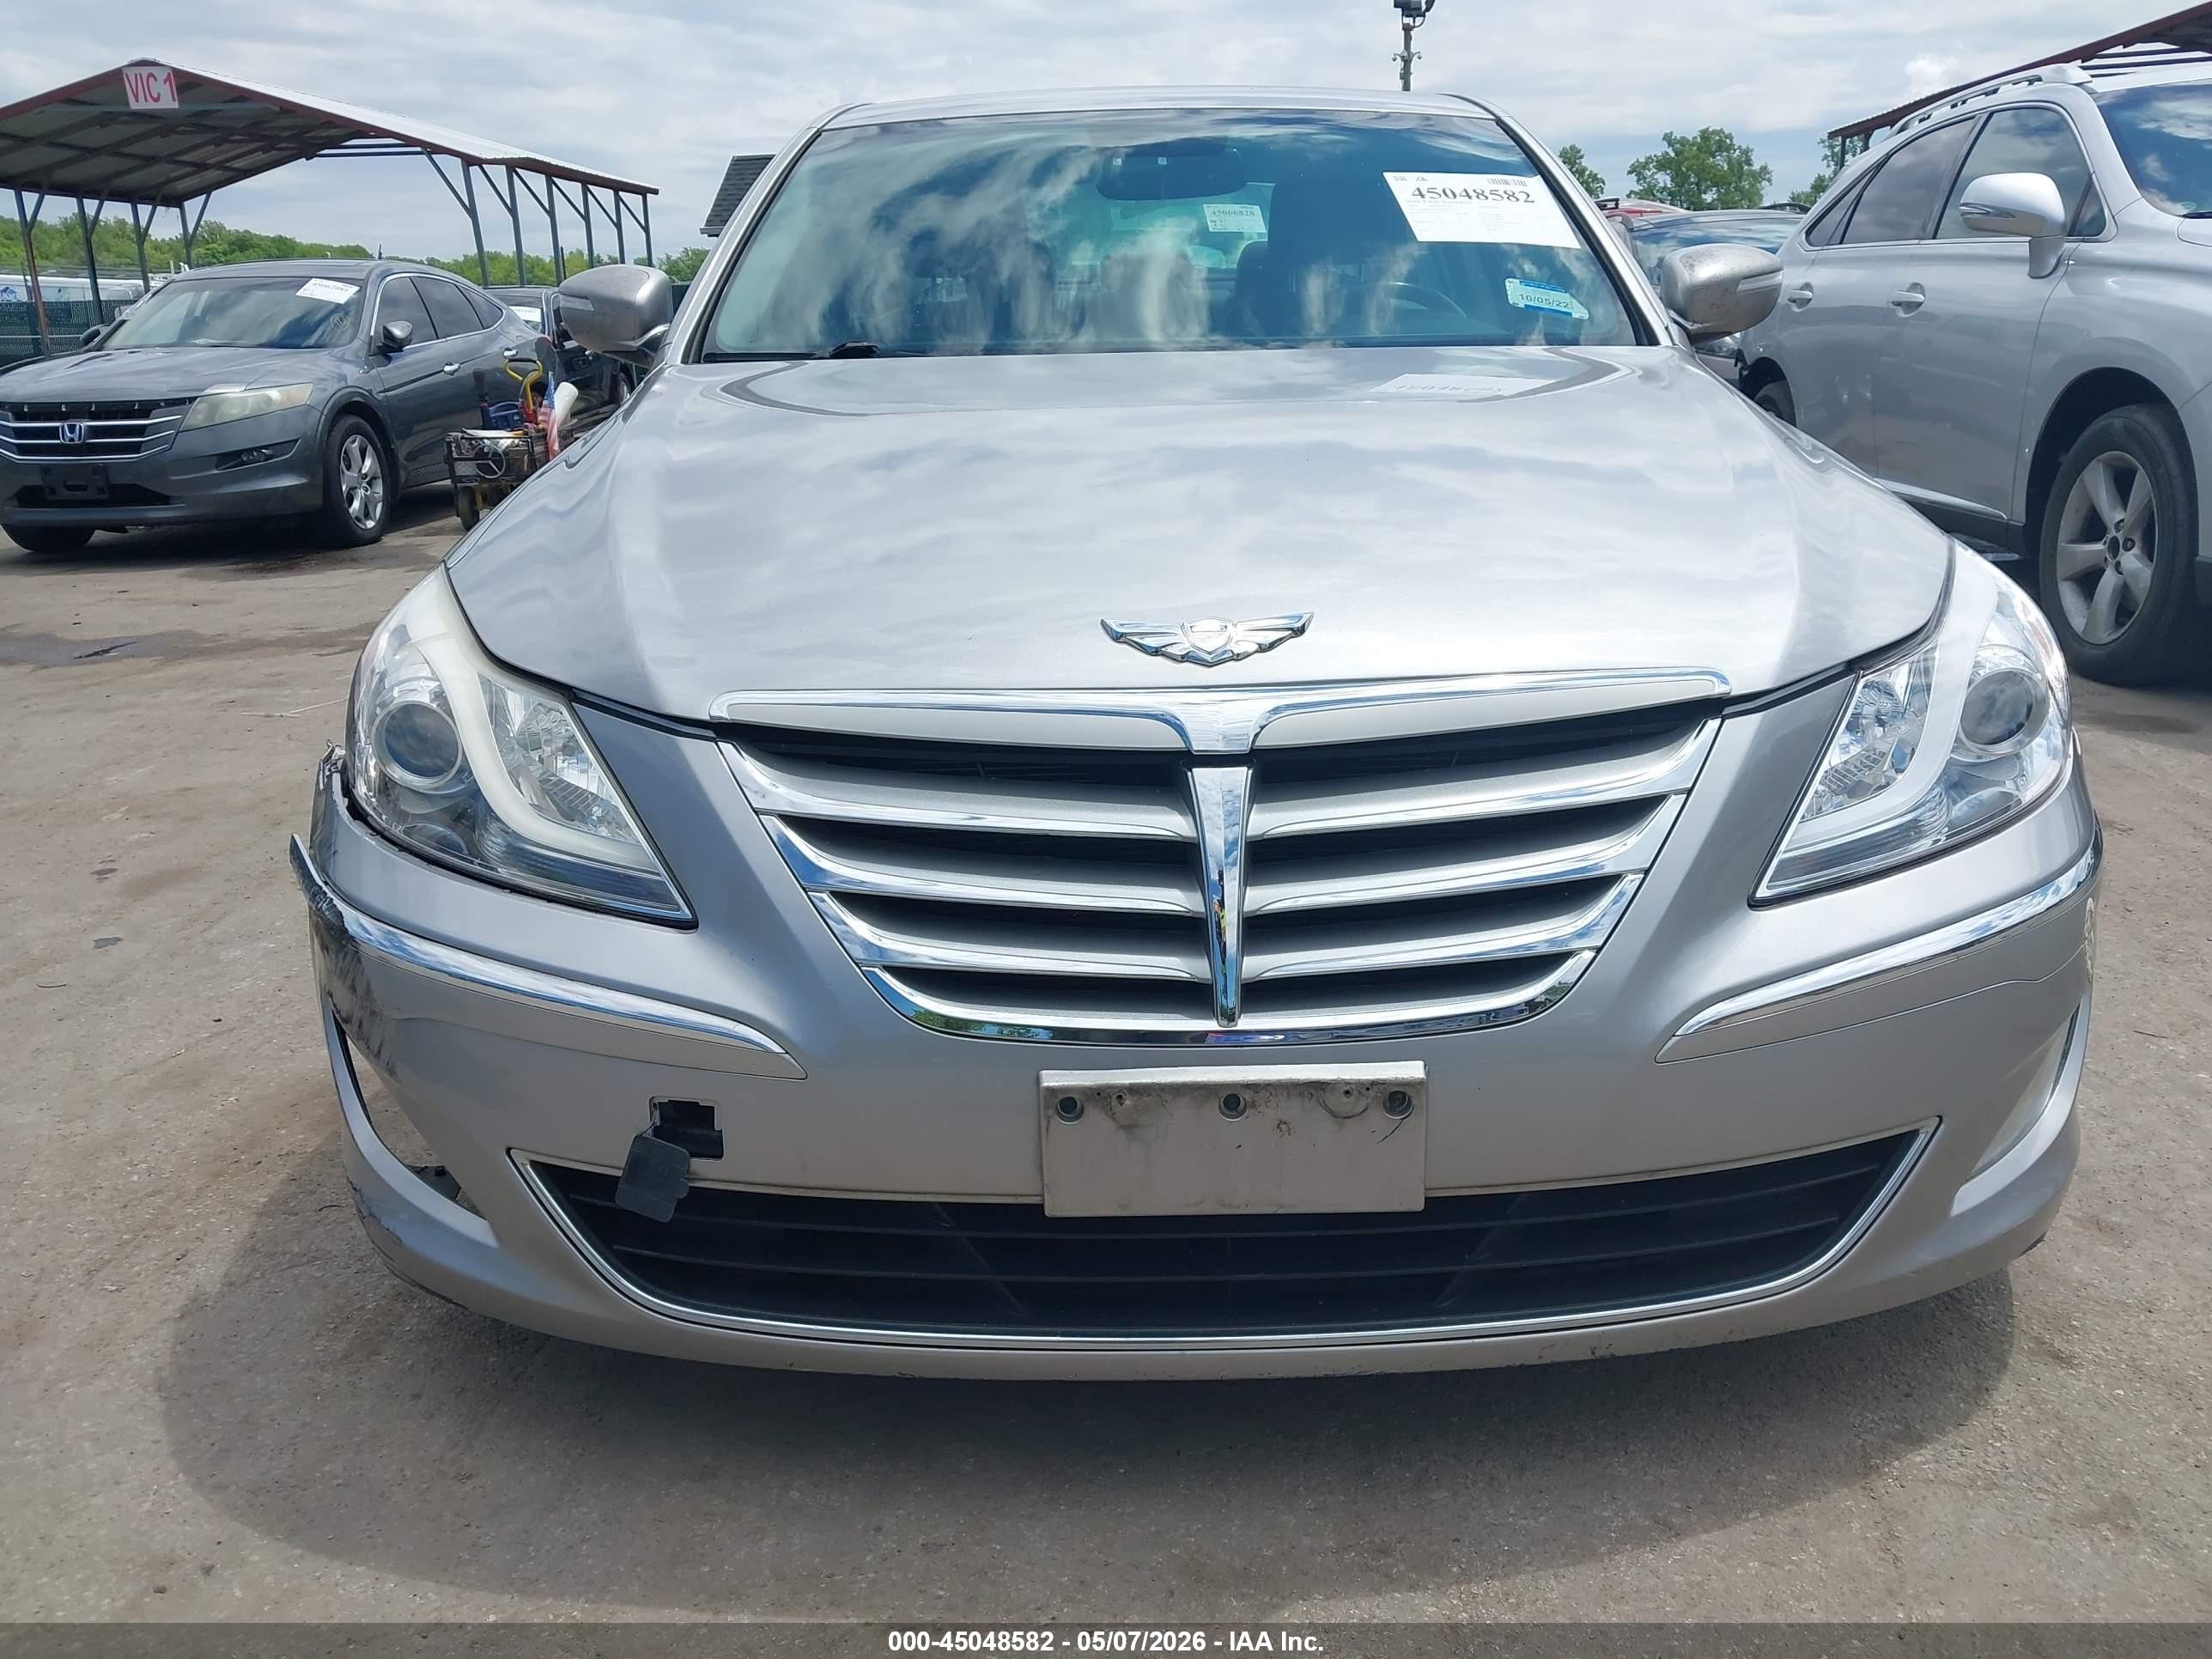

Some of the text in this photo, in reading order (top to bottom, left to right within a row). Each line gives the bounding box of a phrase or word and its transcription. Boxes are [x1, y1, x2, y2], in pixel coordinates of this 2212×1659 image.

[124, 71, 177, 103] VIC 1
[1411, 186, 1535, 204] 45048582
[1518, 294, 1571, 309] 10/05/22
